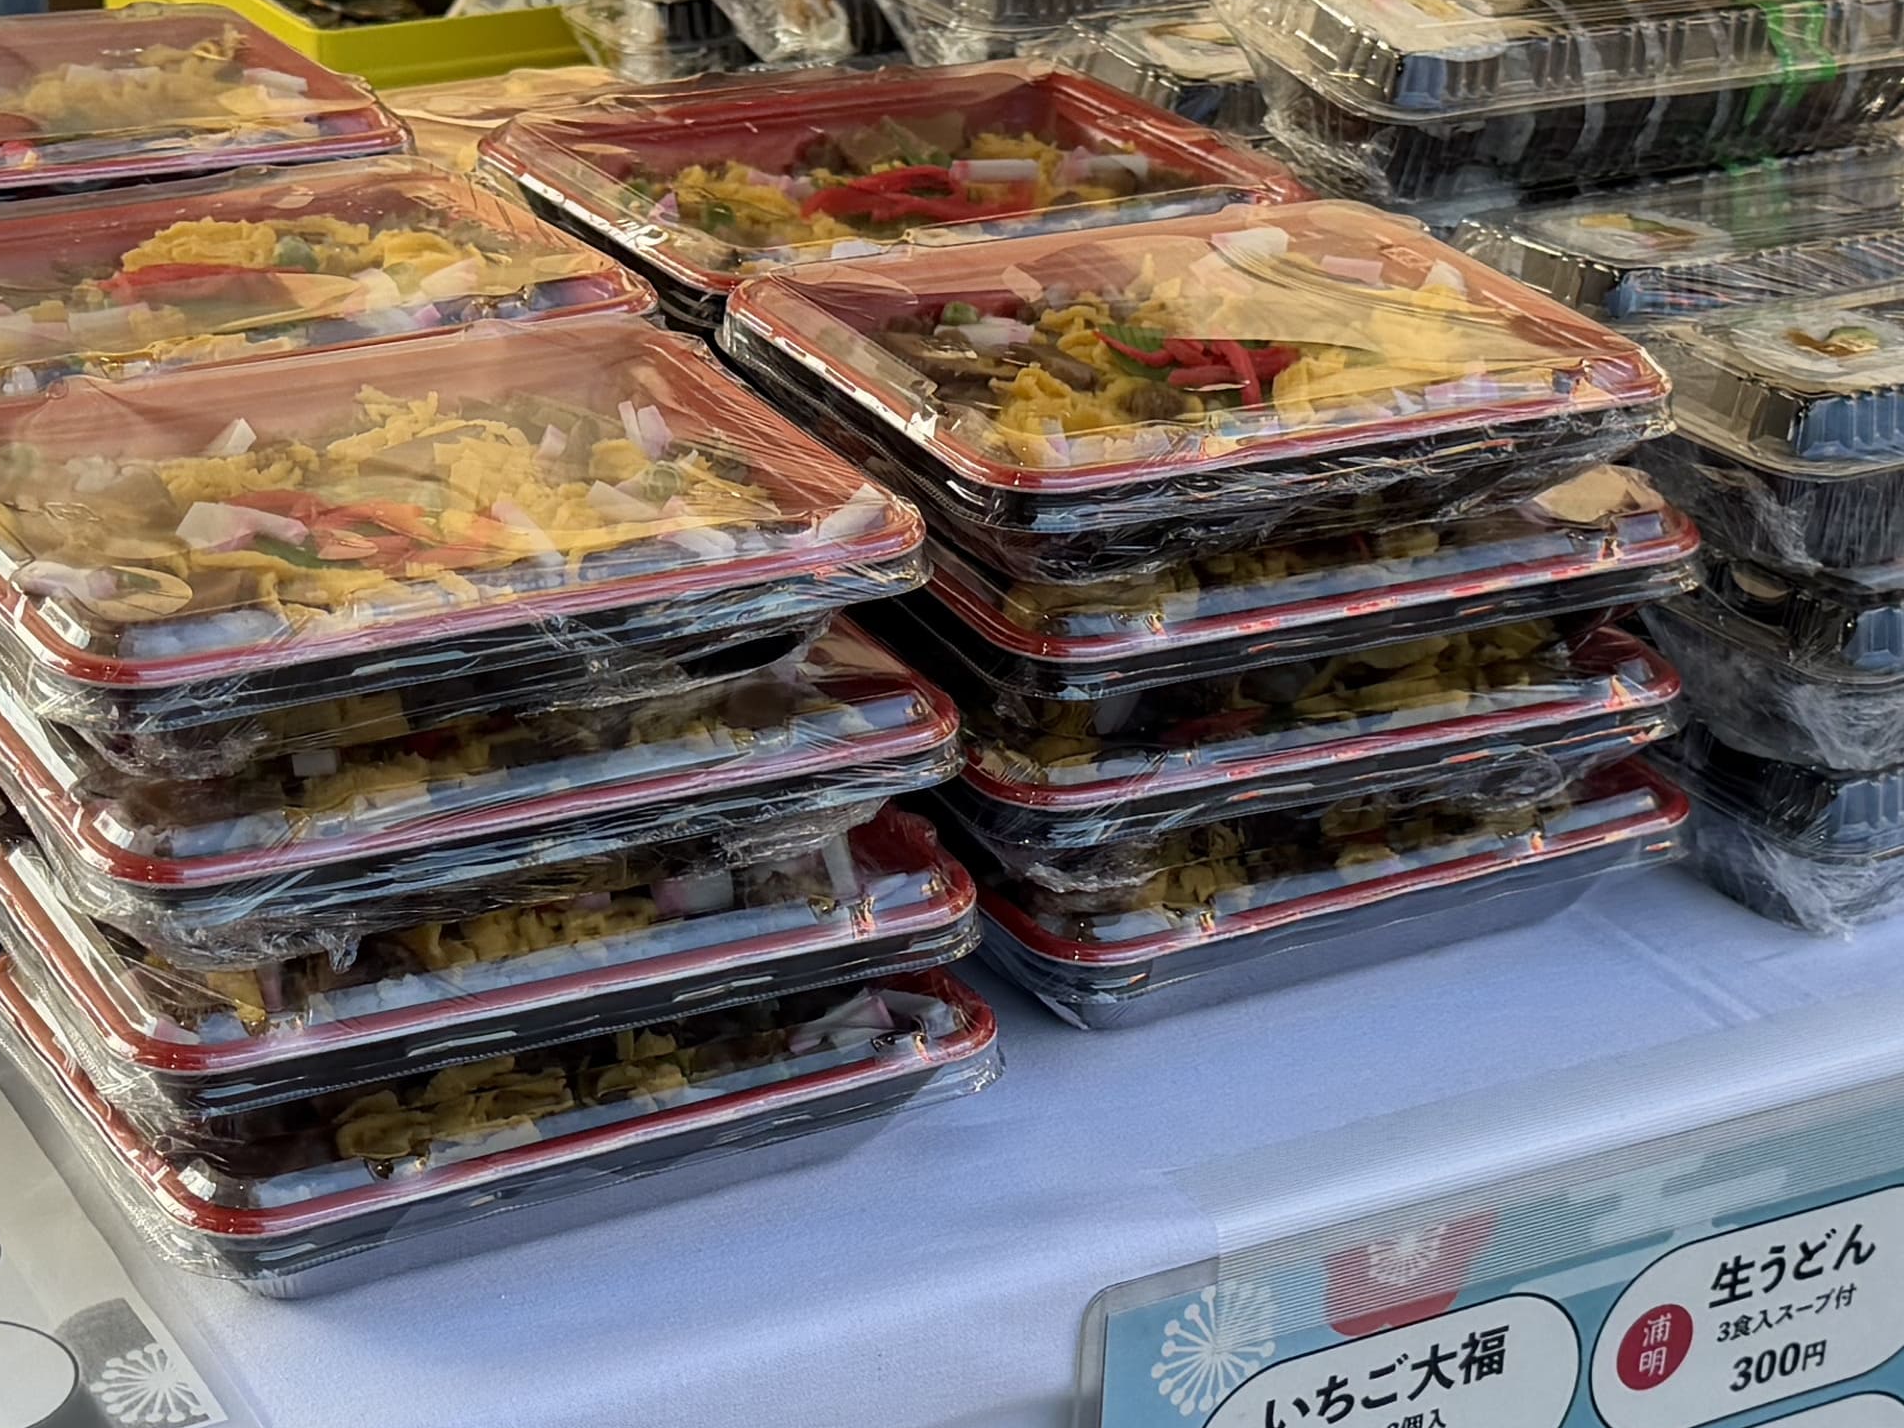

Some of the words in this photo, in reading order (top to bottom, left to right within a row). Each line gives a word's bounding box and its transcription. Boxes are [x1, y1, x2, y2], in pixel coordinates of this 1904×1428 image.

[1708, 1223, 1876, 1309] 生うどん
[1637, 1311, 1674, 1378] 浦明
[1716, 1282, 1857, 1343] 3食入スープ付
[1729, 1339, 1827, 1392] 300円
